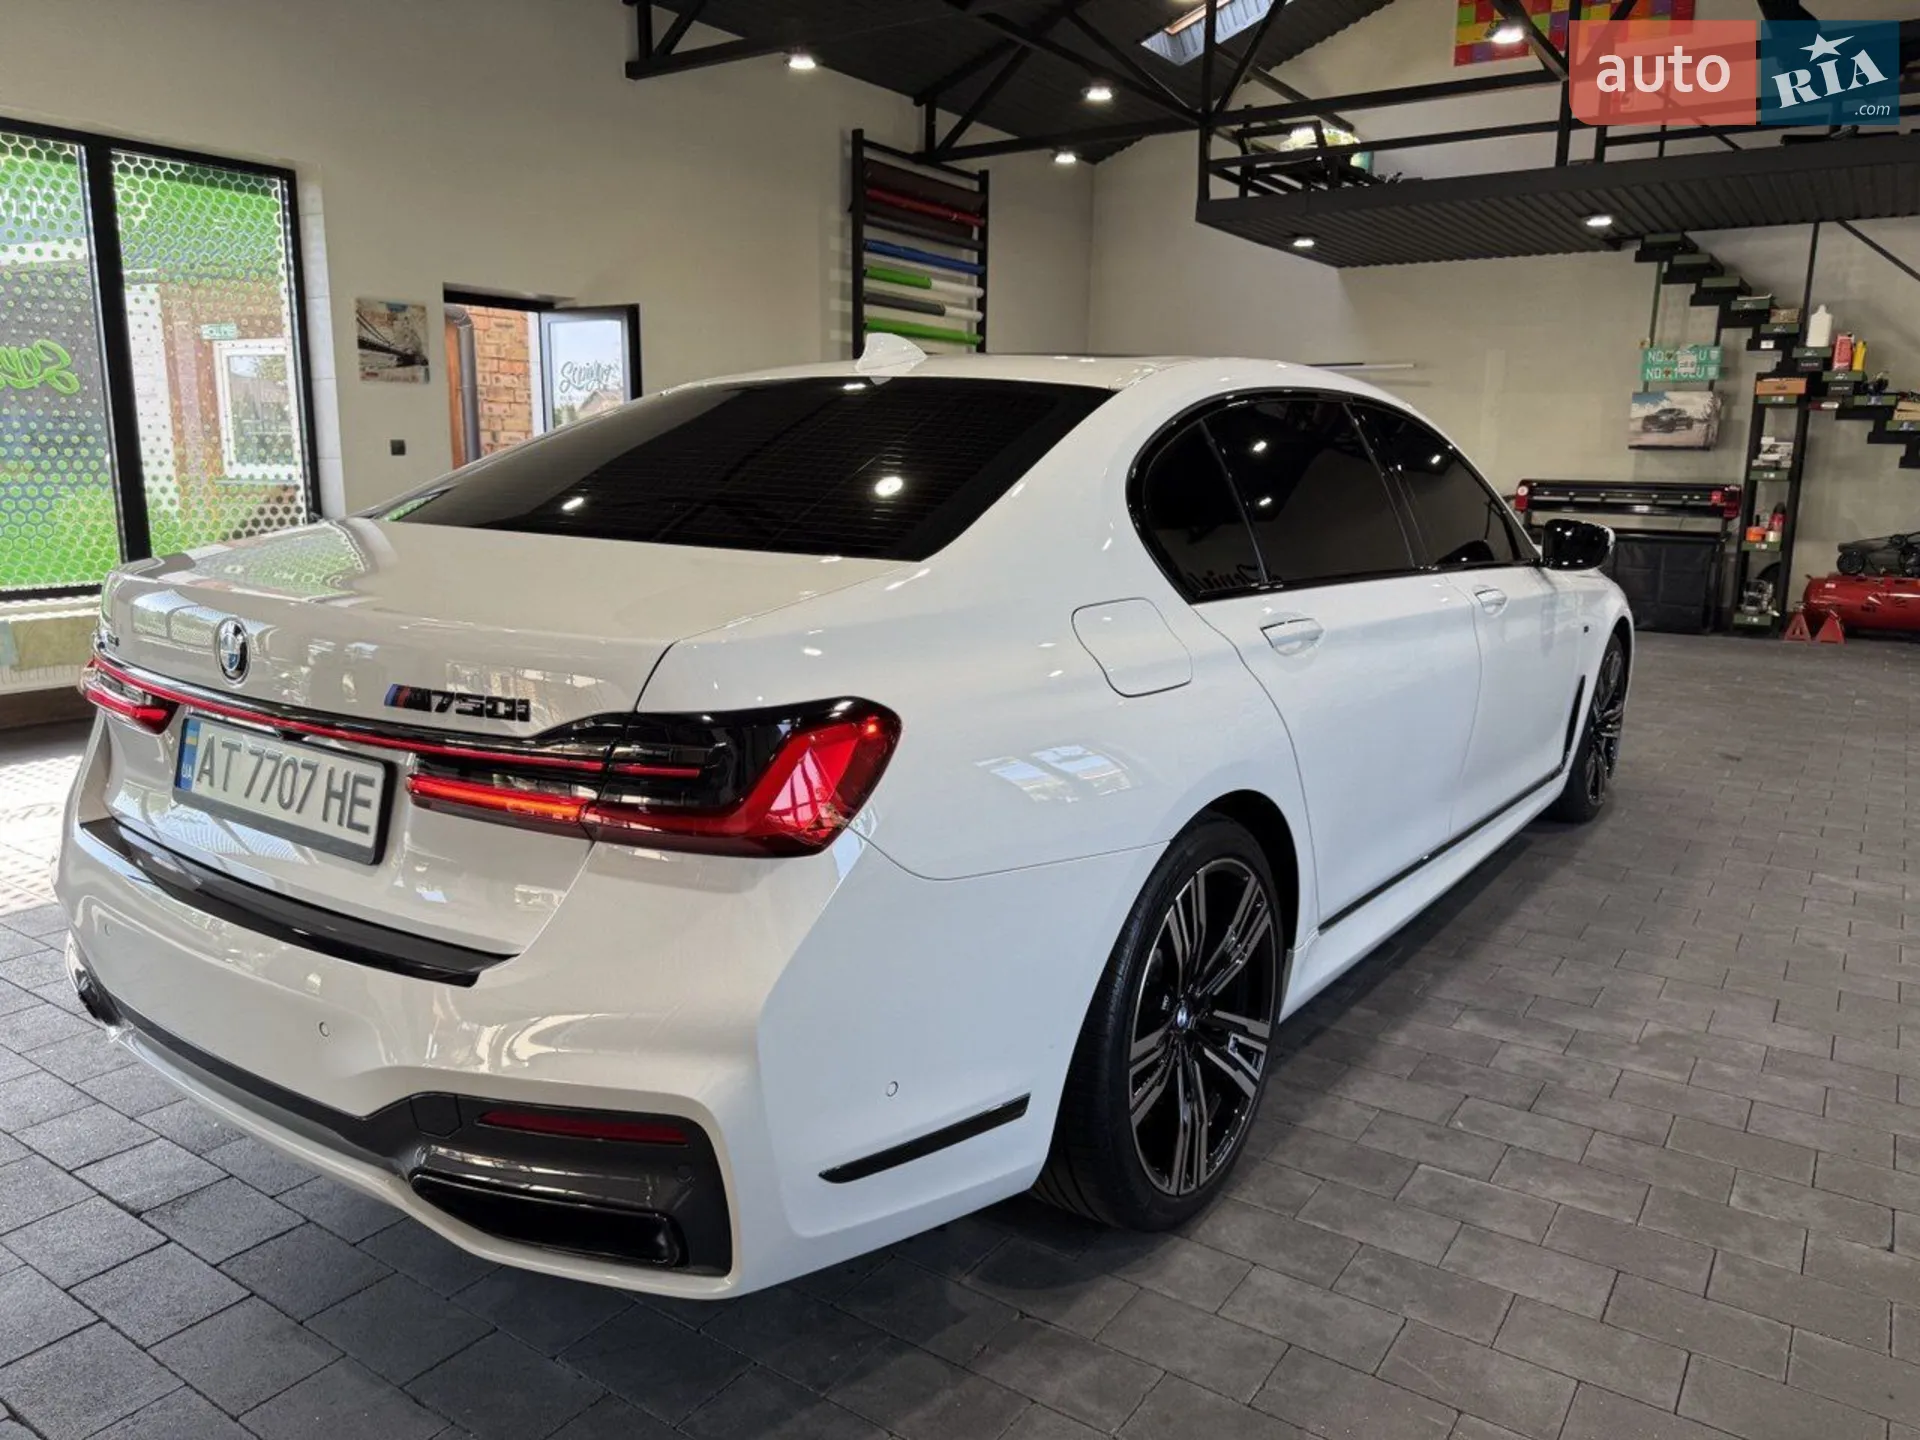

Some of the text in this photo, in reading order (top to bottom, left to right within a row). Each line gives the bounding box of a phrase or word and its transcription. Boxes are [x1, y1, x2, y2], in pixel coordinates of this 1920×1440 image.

[196, 735, 376, 836] AT 7707 HE
